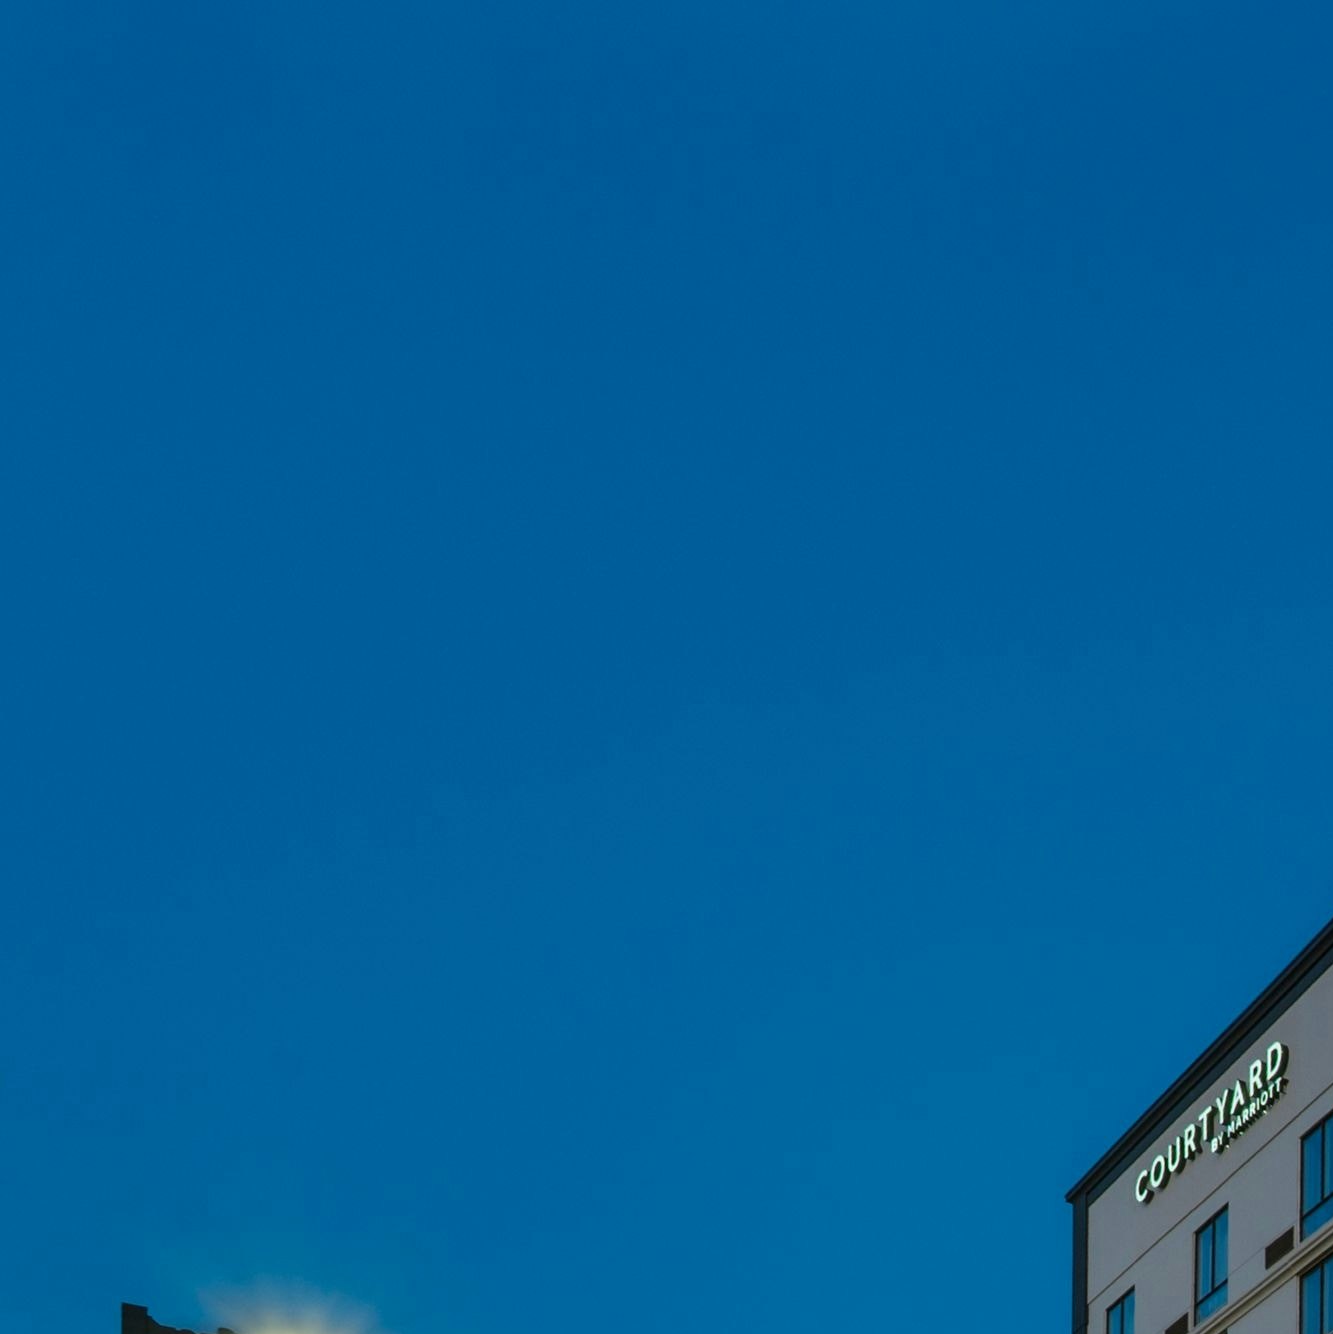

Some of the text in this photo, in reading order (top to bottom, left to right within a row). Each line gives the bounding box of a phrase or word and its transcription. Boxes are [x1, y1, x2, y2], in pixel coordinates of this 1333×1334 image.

[1135, 1041, 1283, 1202] COURTYARD
[1210, 1076, 1282, 1153] BY MARRIOTT
